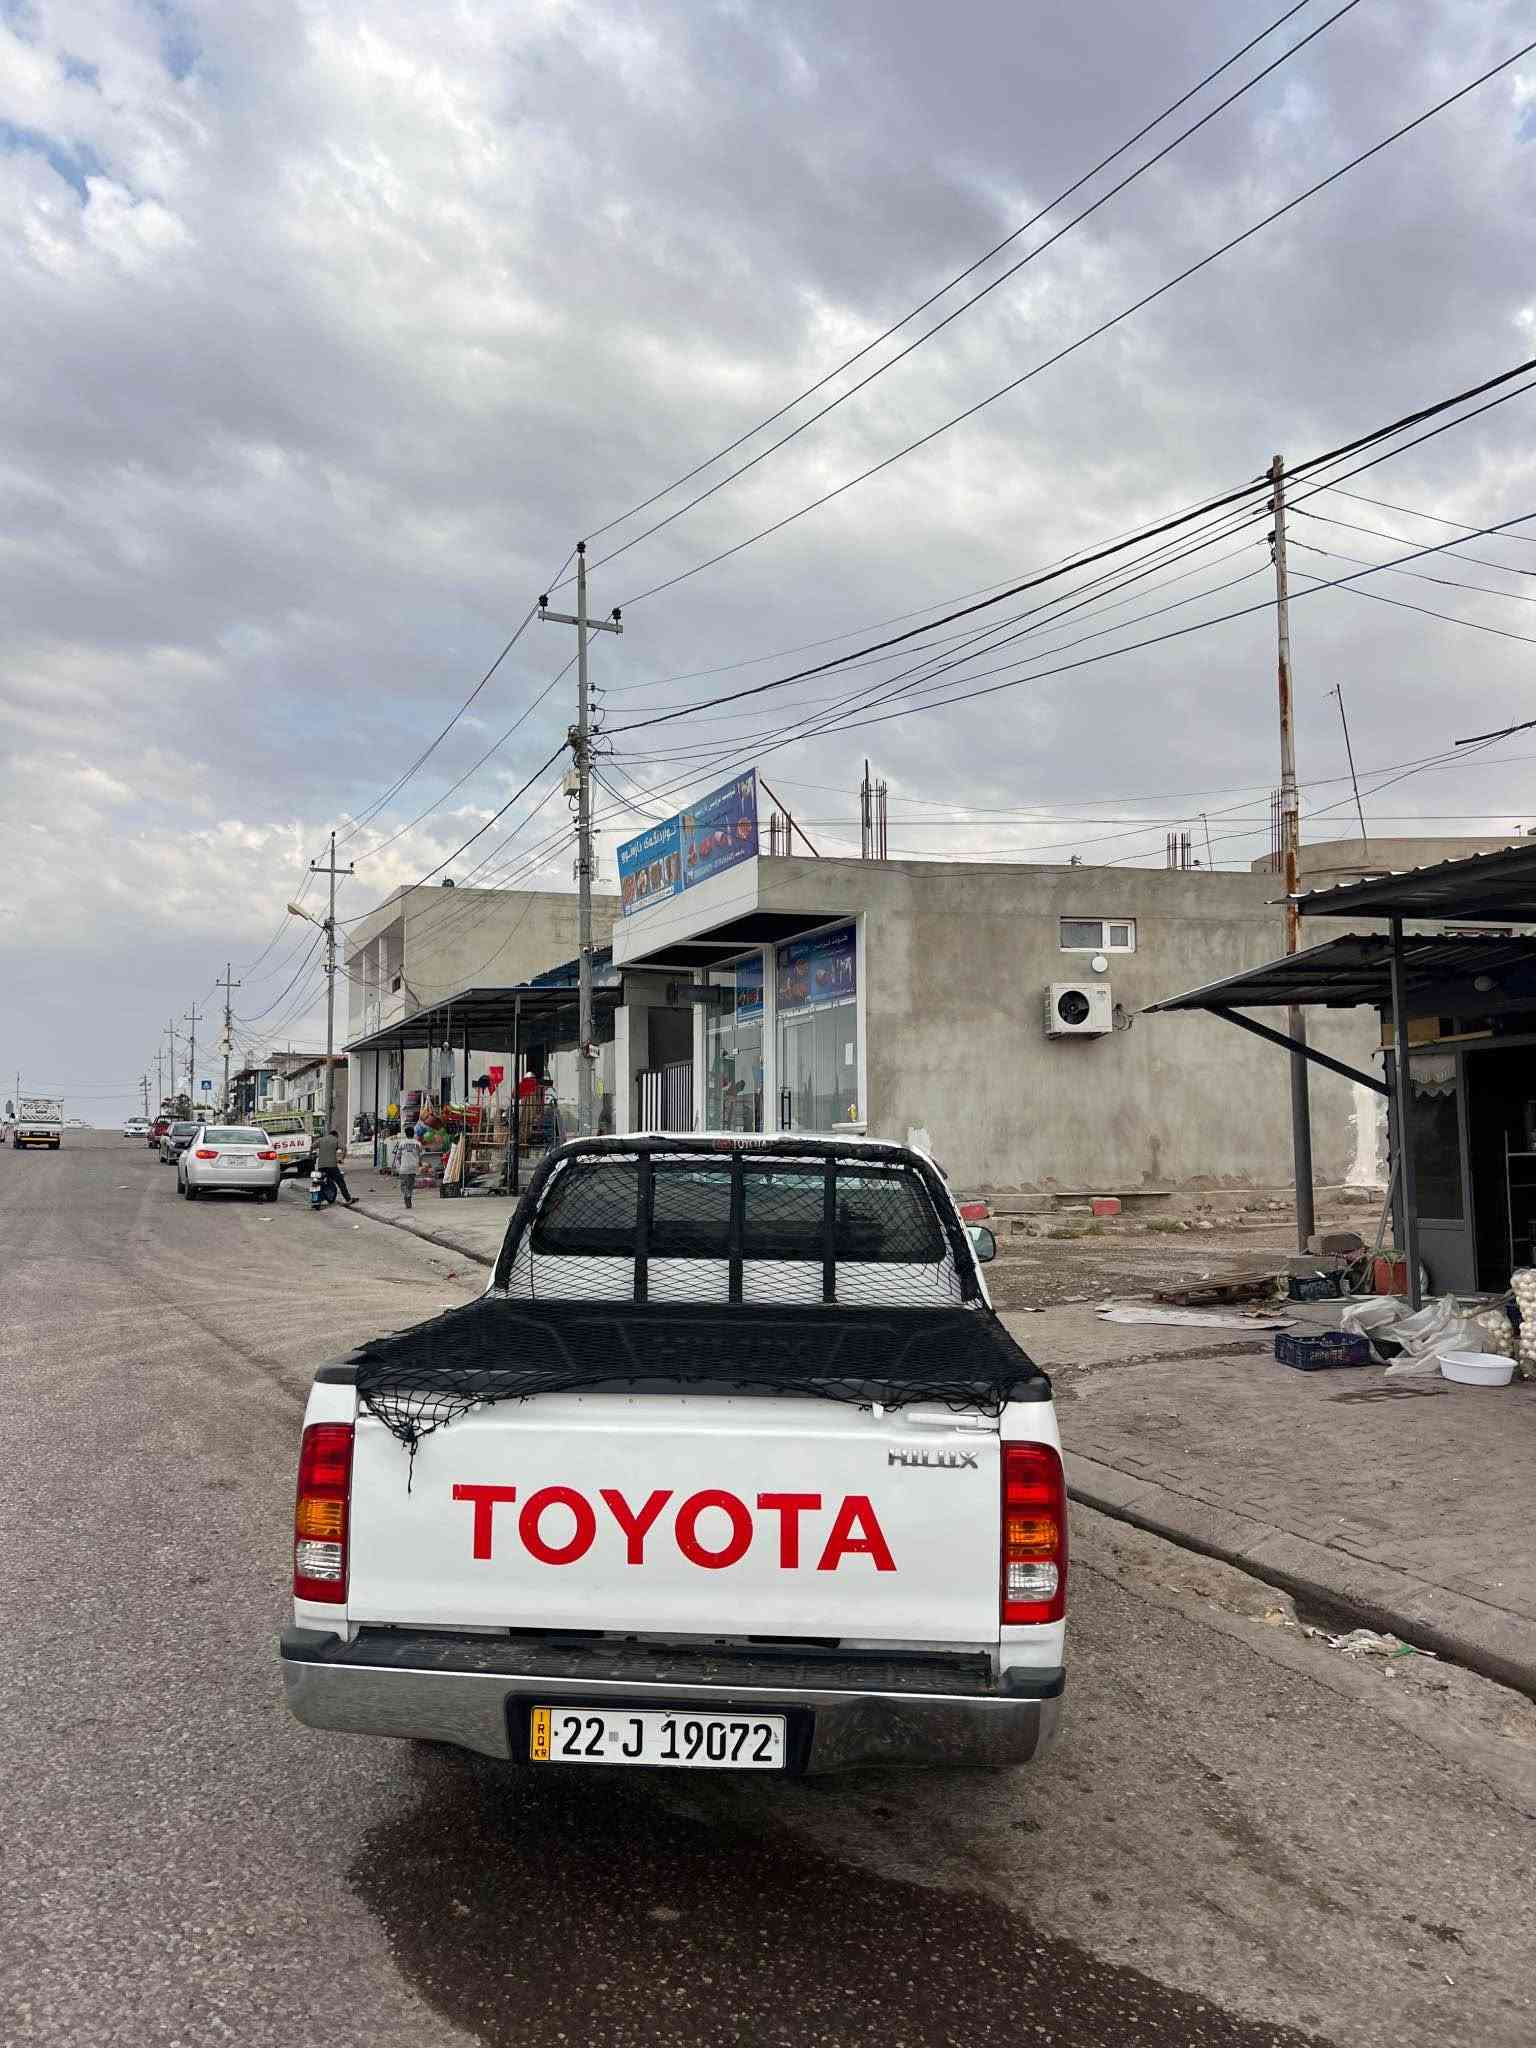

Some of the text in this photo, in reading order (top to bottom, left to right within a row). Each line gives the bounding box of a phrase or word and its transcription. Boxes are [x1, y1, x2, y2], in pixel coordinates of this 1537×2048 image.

[272, 1140, 304, 1150] SSAN
[888, 1448, 978, 1469] HILUX
[452, 1483, 898, 1572] TOYOTA
[562, 1716, 773, 1762] 22 J 19072
